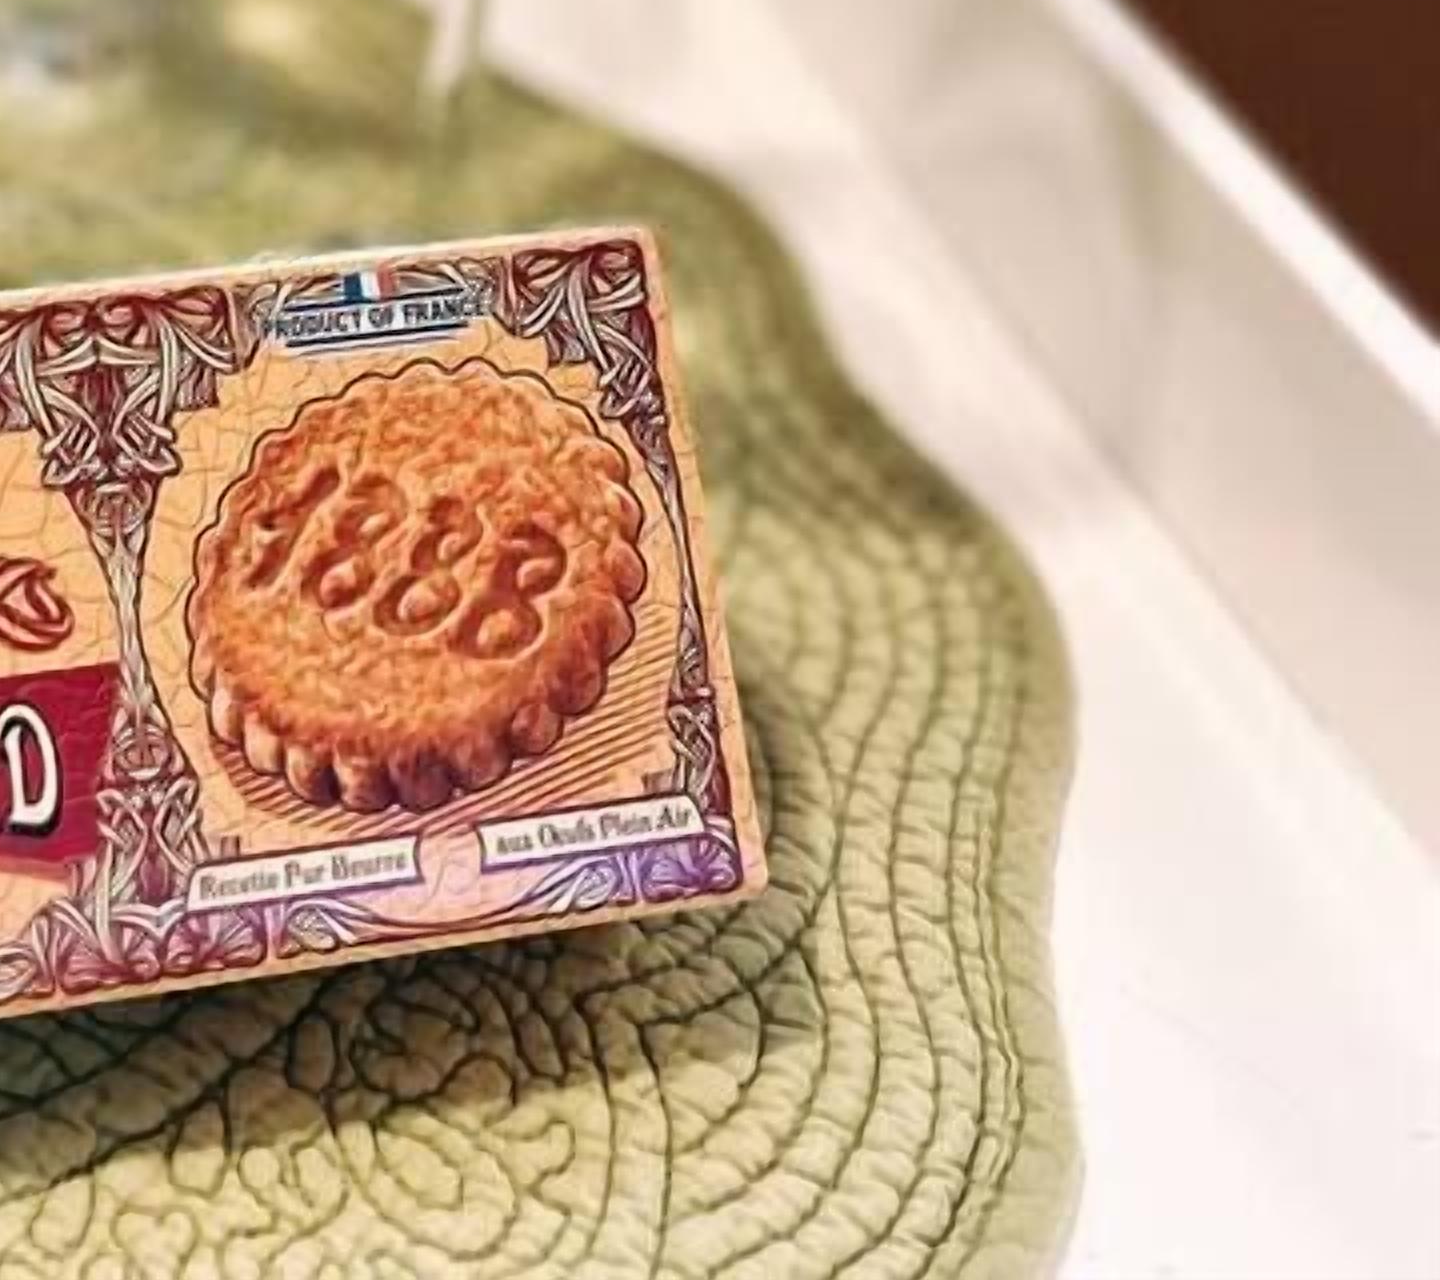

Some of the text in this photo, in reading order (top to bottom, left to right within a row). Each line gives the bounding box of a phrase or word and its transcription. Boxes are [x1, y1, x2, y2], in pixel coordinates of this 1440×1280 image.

[262, 296, 485, 337] PRODUCT OF FRANCE
[656, 803, 693, 830] Air
[284, 859, 325, 888] Pur
